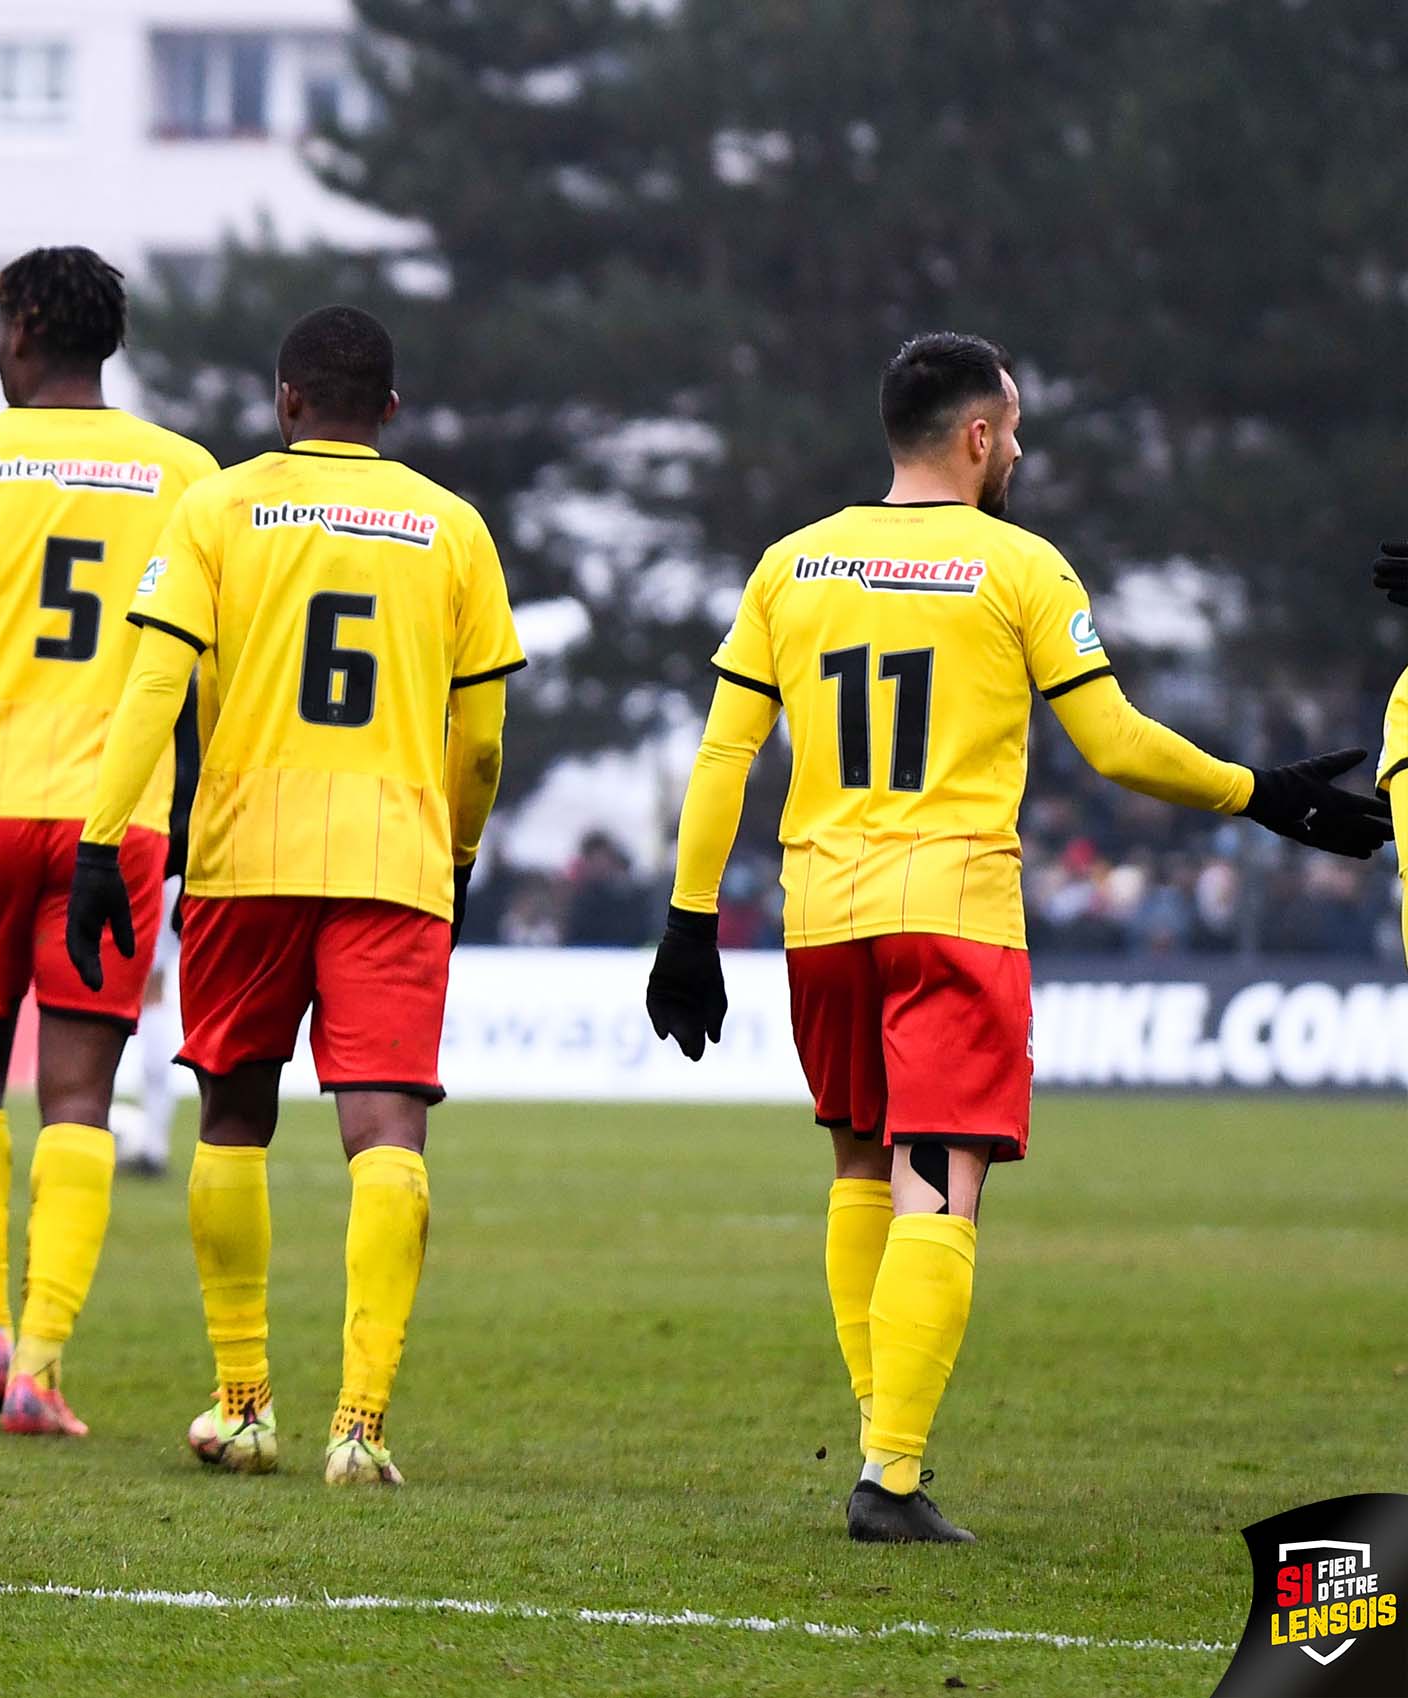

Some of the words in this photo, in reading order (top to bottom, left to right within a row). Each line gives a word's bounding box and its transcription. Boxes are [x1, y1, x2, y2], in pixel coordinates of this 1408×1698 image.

[253, 503, 436, 536] Intermarché
[795, 555, 985, 582] Intermarché
[34, 535, 105, 662] 5
[298, 591, 377, 728] 6
[820, 642, 935, 792] 11
